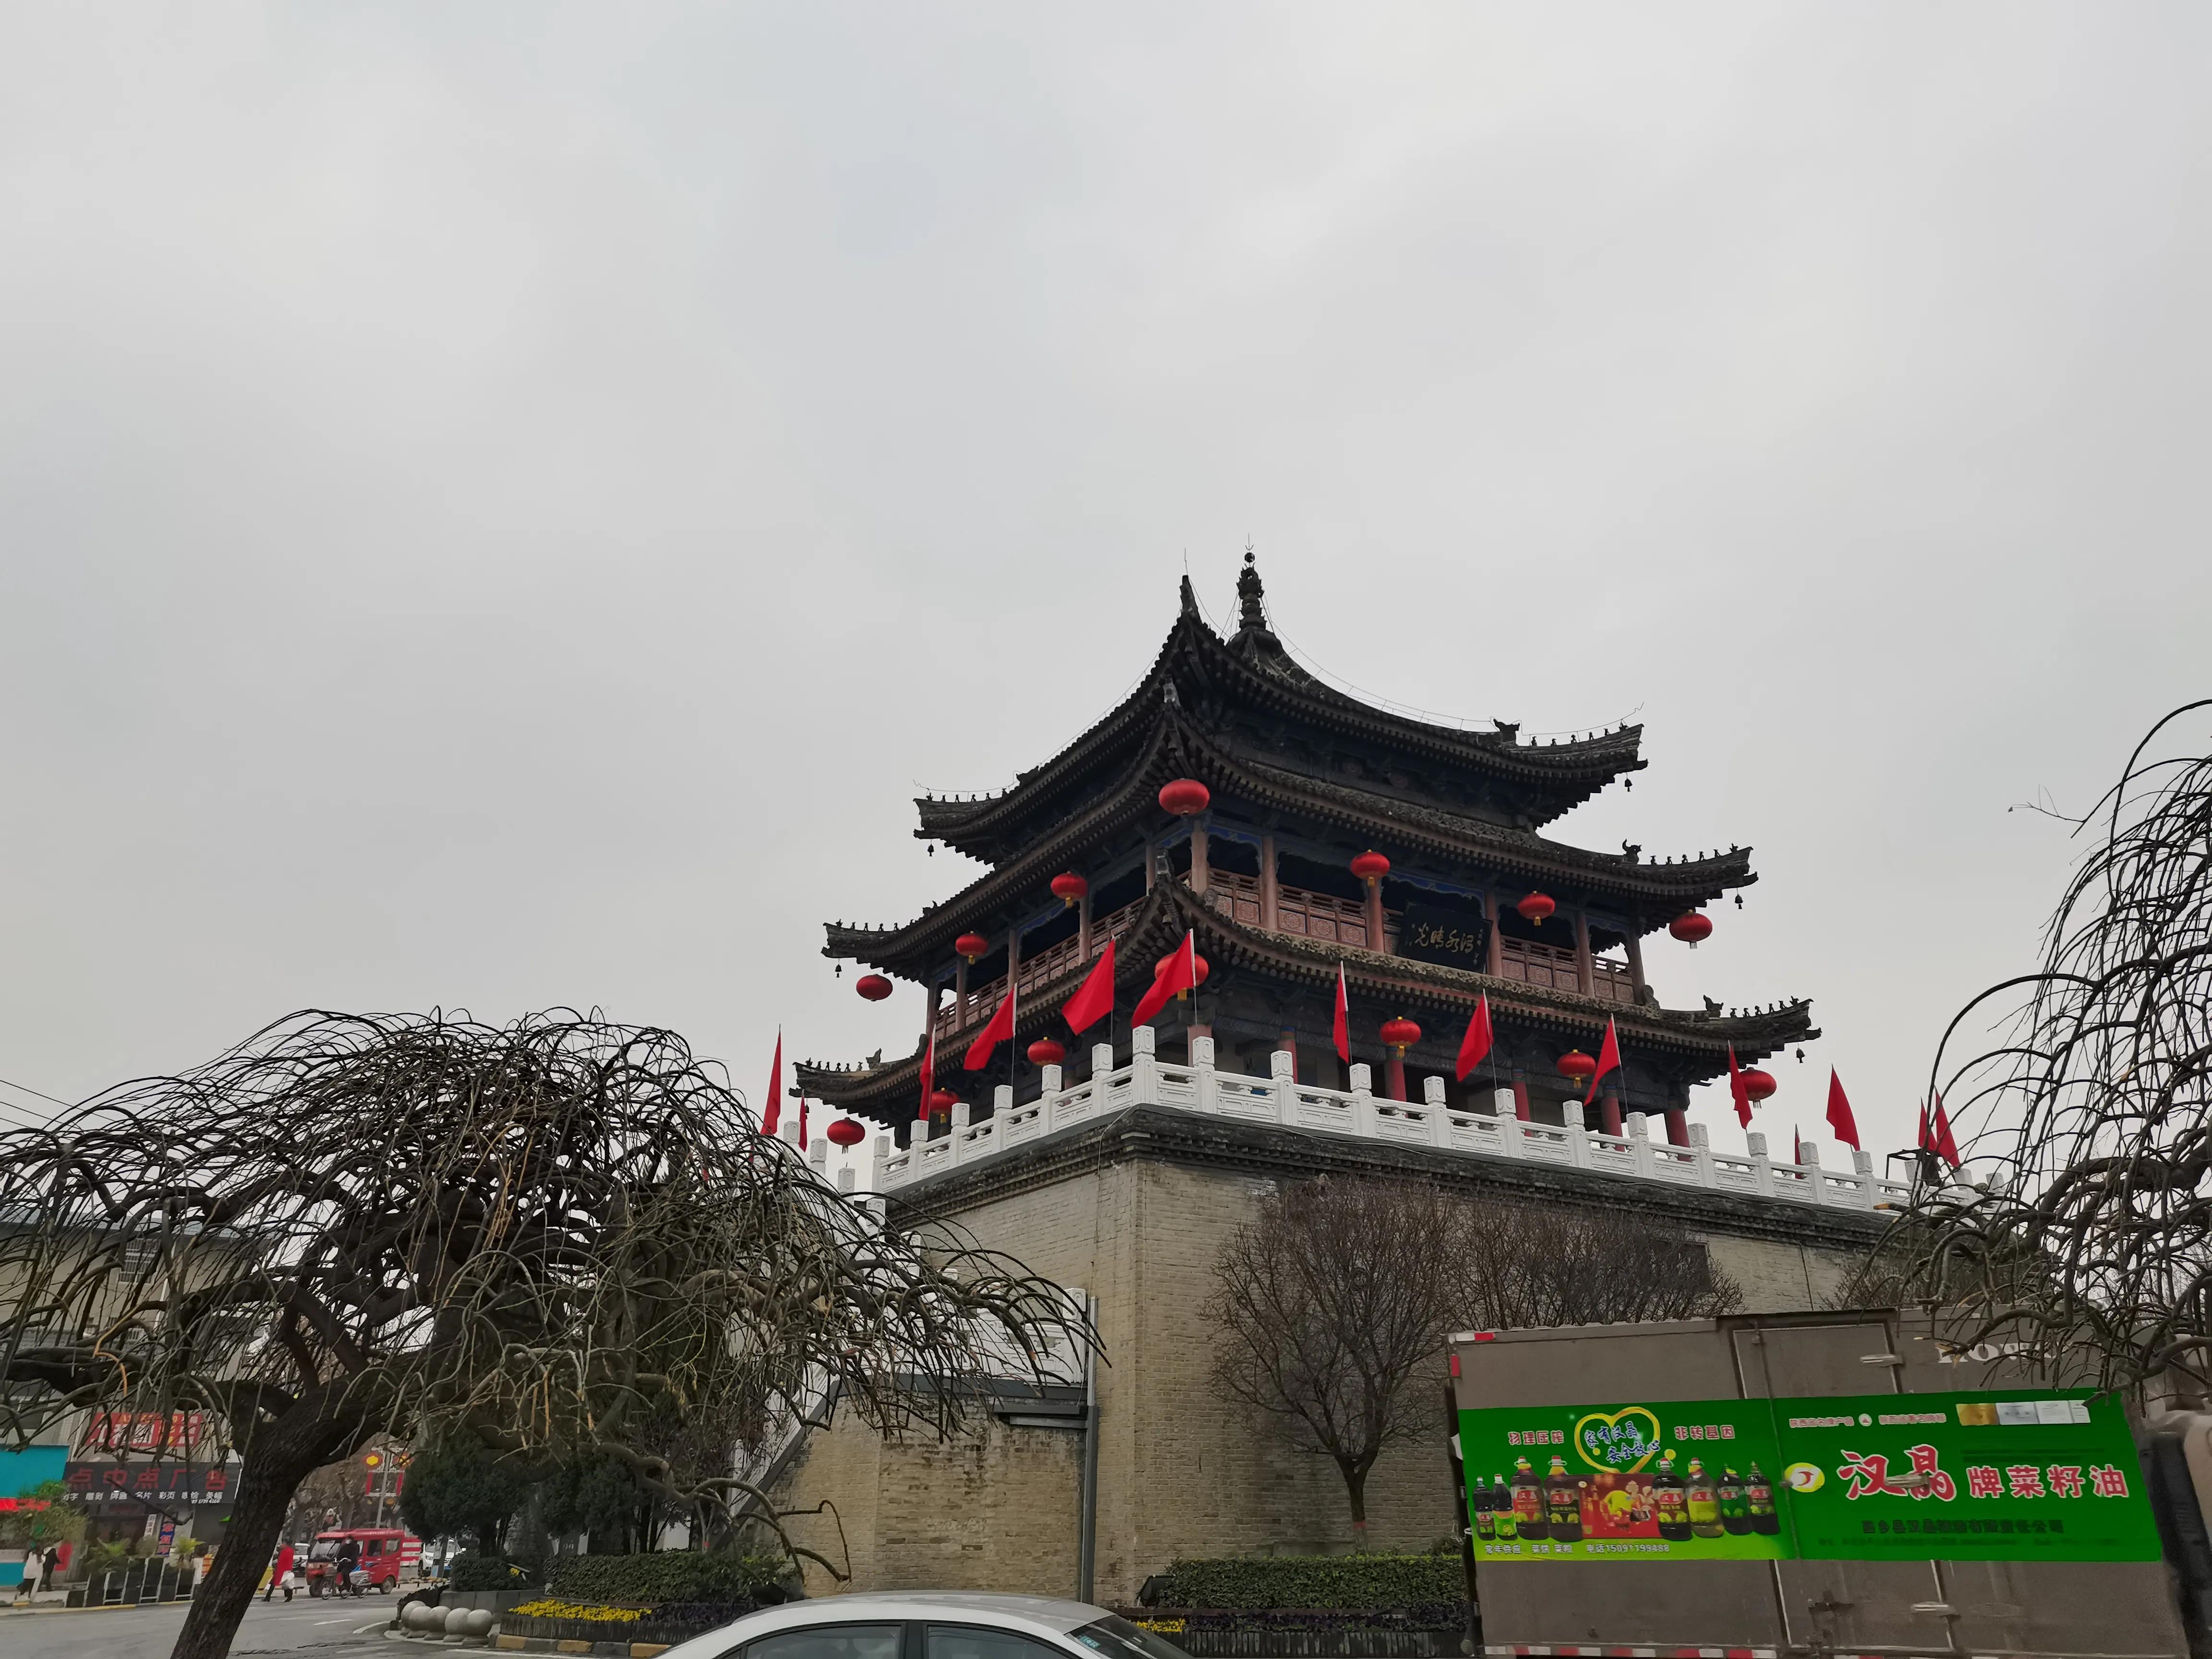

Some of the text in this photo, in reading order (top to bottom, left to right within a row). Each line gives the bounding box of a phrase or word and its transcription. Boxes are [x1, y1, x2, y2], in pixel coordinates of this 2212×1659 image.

[1674, 1425, 1735, 1441] 非转基因
[1606, 1440, 1660, 1463] 安全放心
[68, 1467, 228, 1491] 点中点广告
[1966, 1465, 2129, 1499] 牌菜籽油
[135, 1491, 153, 1500] 名片
[158, 1491, 177, 1500] 彩页
